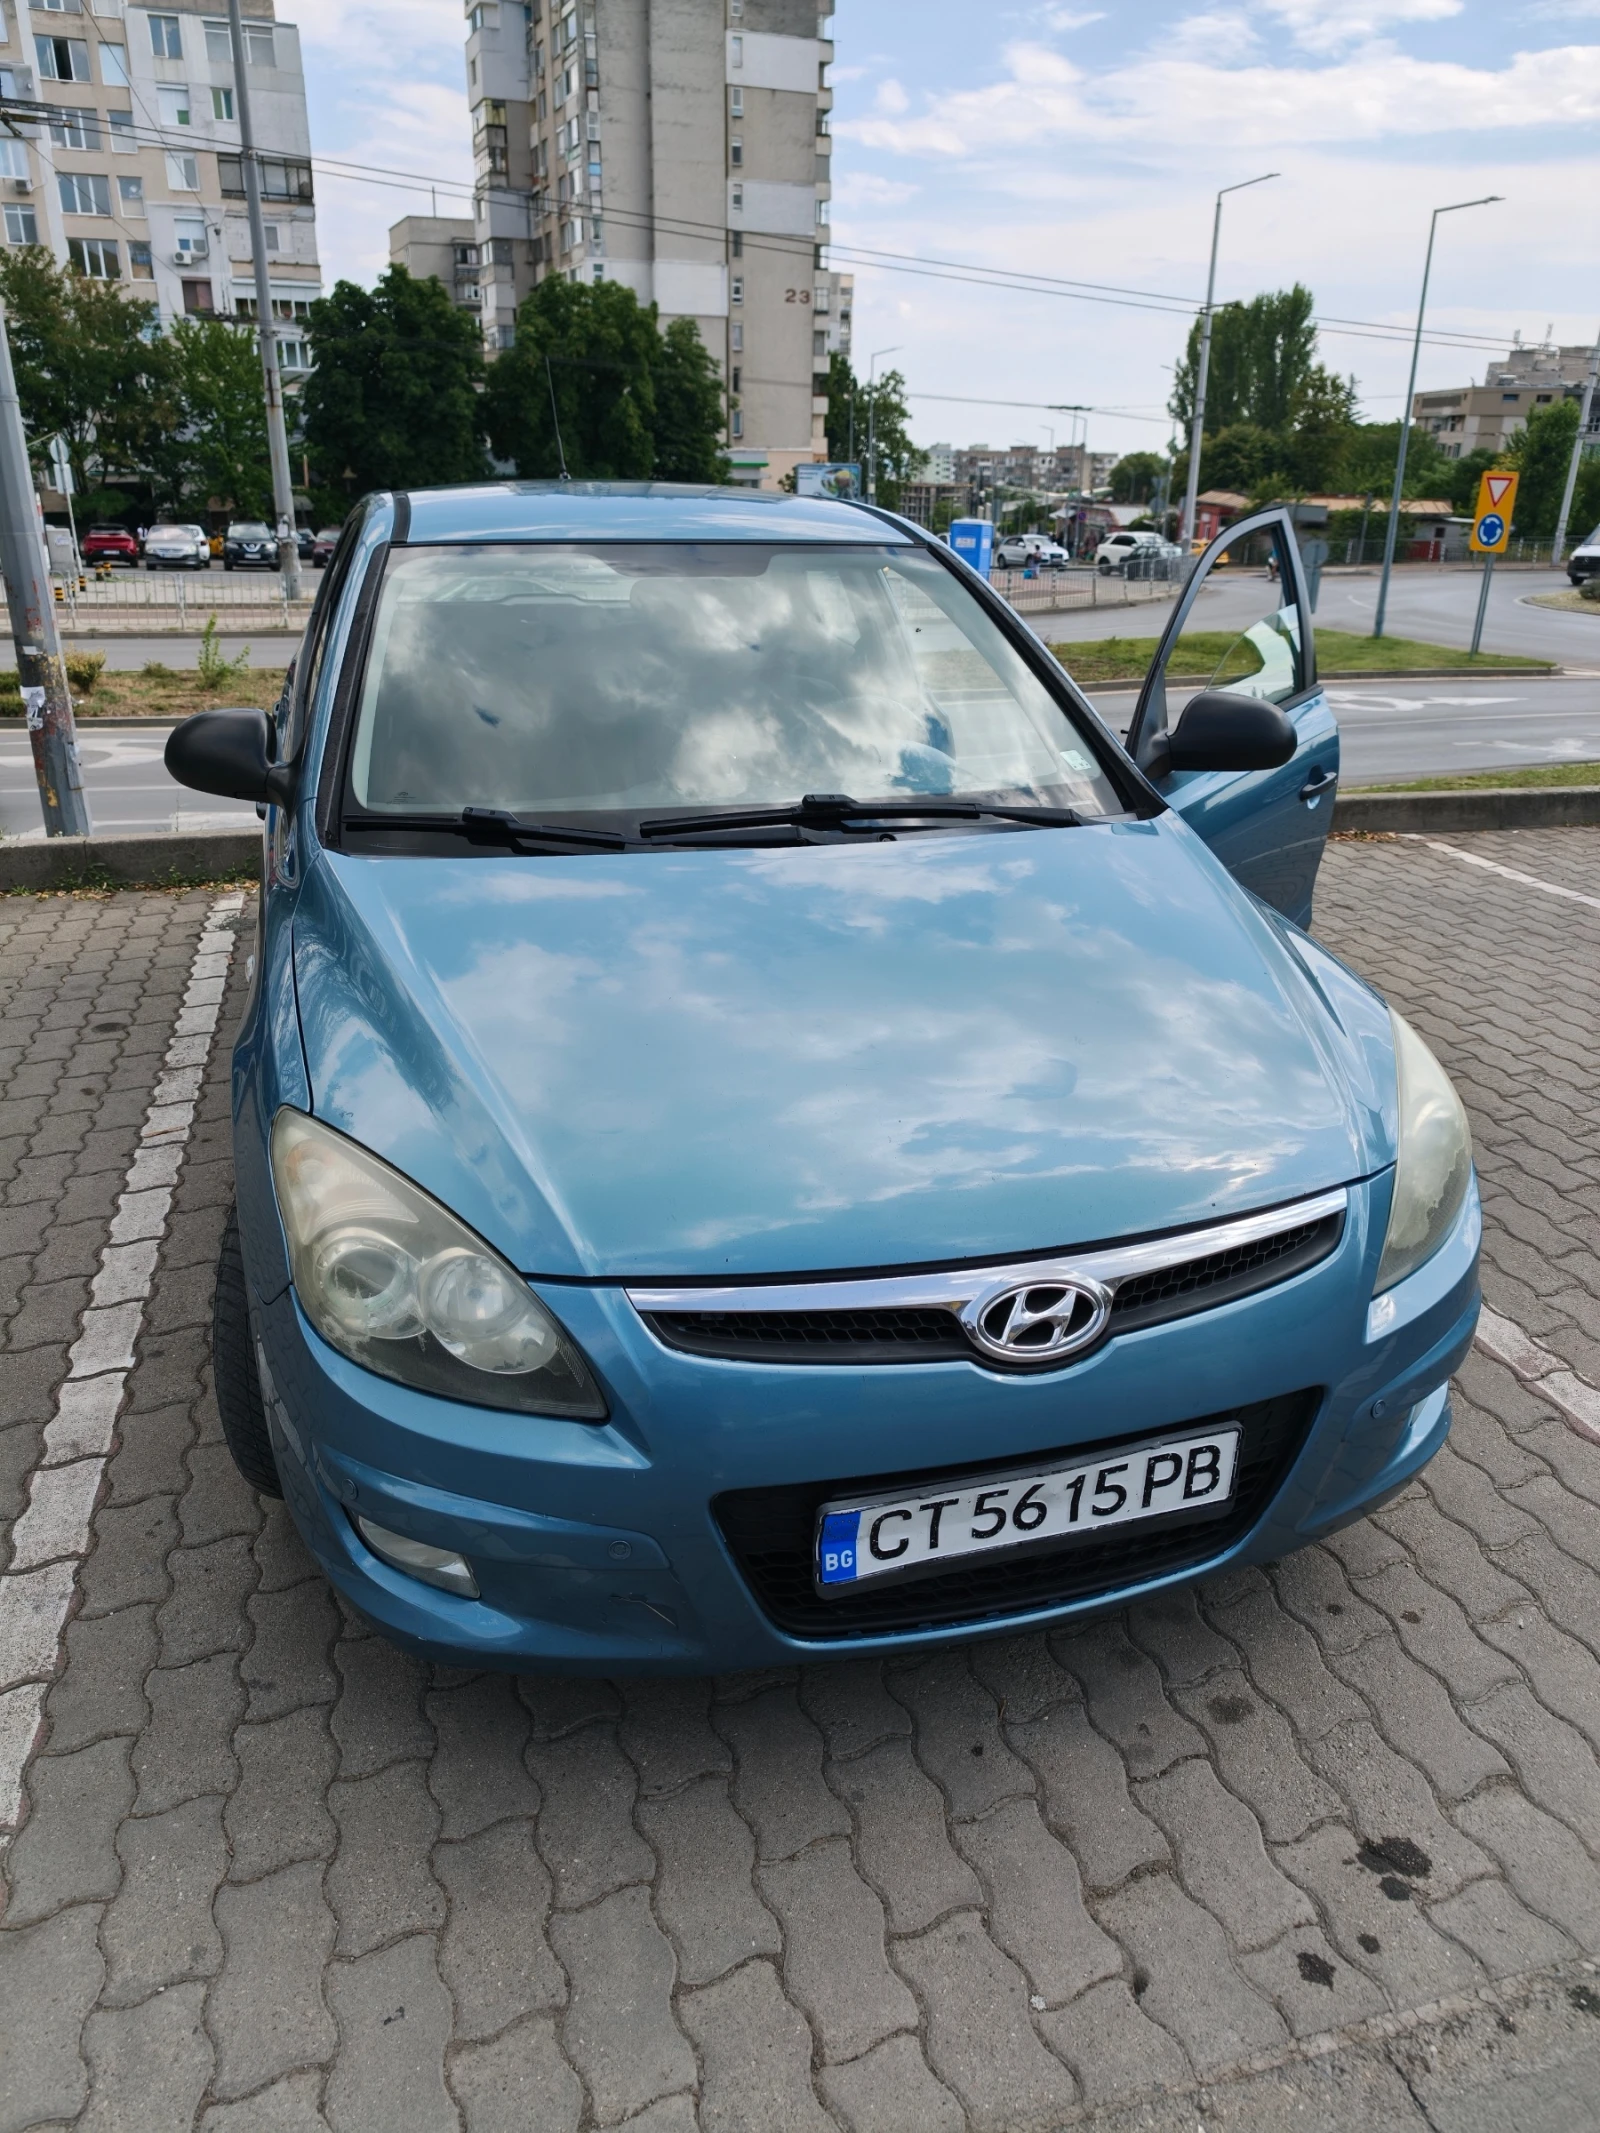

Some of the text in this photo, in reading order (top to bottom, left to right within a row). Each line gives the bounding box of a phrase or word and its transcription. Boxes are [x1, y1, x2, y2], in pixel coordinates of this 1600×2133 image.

[784, 288, 811, 304] 23
[869, 1444, 1222, 1561] CT 5615 PB
[825, 1550, 853, 1572] BG
